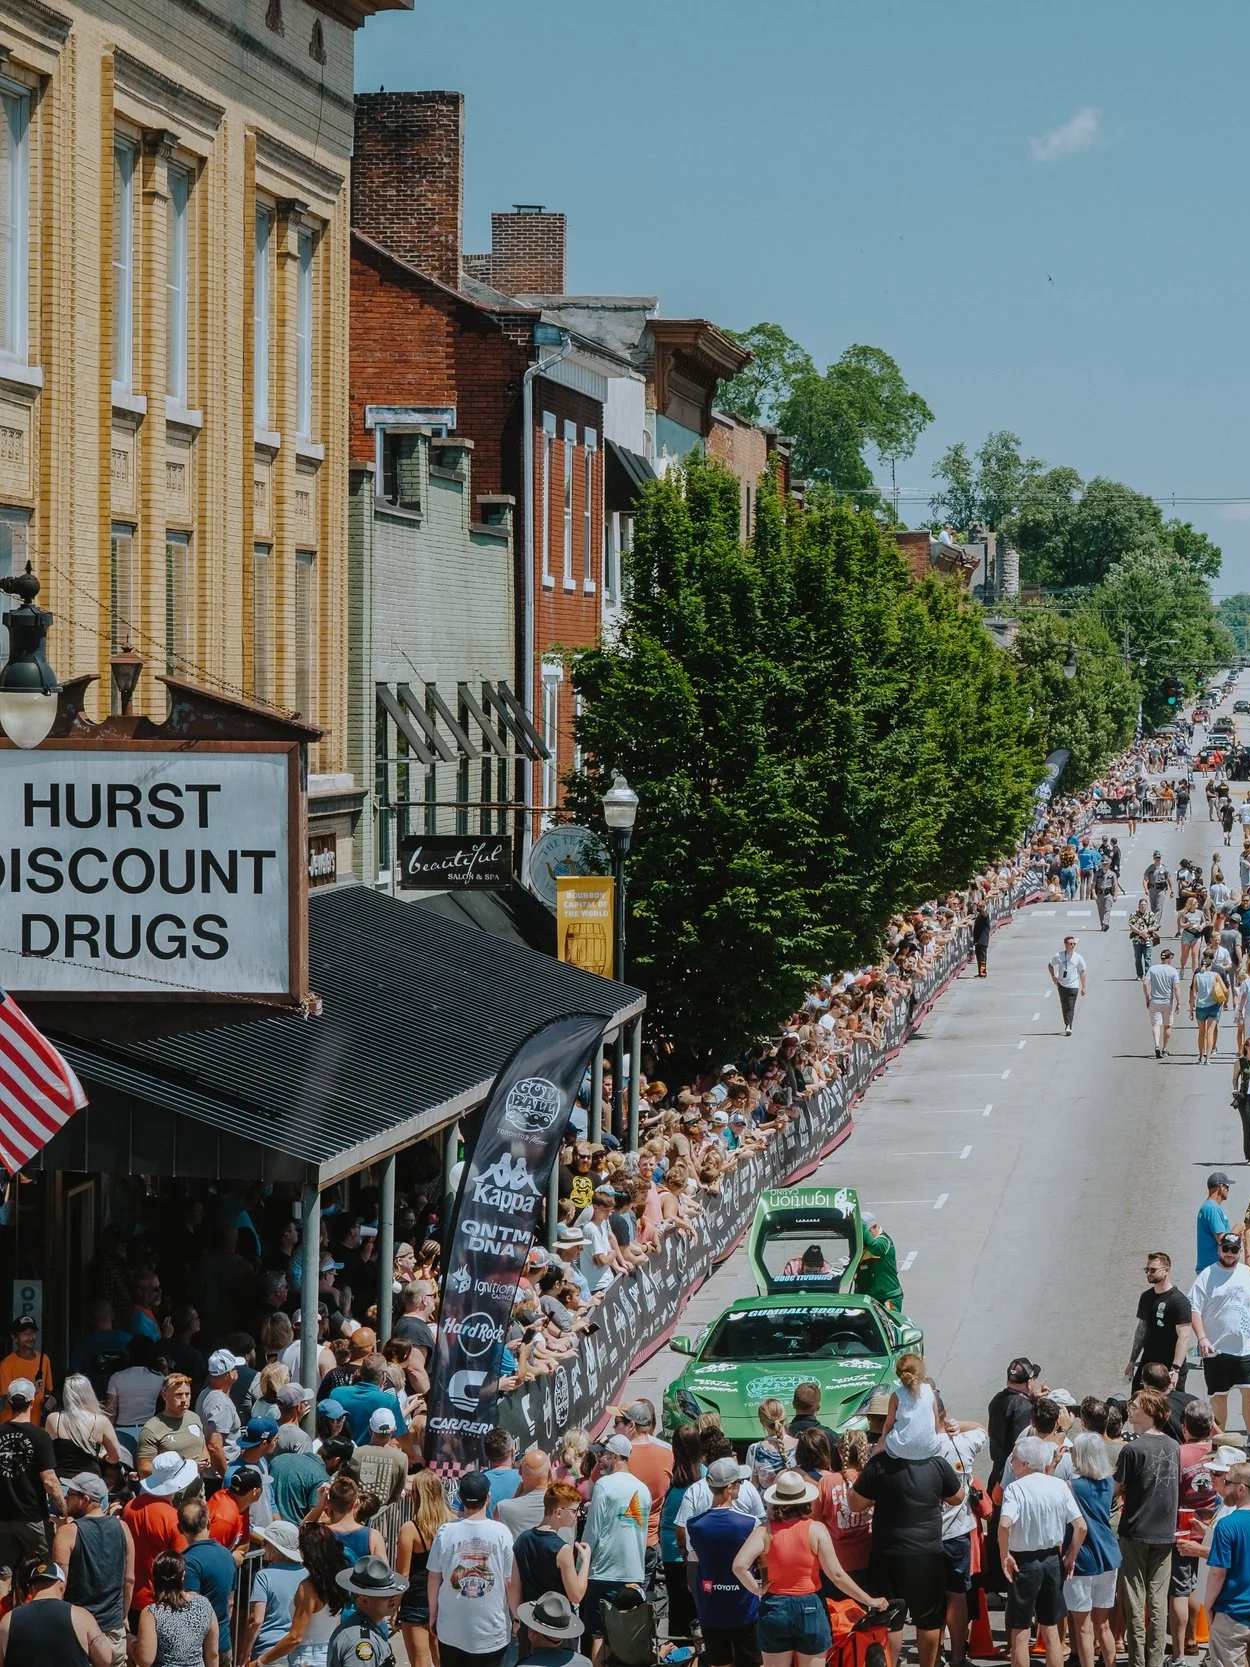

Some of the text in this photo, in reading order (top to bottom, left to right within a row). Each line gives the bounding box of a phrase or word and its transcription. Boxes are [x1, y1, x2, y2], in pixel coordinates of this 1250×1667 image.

[23, 783, 221, 829] HURST
[409, 842, 502, 884] beautiful
[566, 891, 605, 899] BOURBON
[21, 914, 229, 960] DRUGS
[496, 1128, 524, 1140] TORONTO
[472, 1182, 536, 1214] Kappa
[770, 1191, 830, 1208] Ignition
[461, 1219, 531, 1244] QNTM
[468, 1236, 515, 1257] DNA
[474, 1279, 514, 1295] Ignition
[20, 1286, 36, 1317] OP
[748, 1307, 808, 1317] GUMBALL
[442, 1317, 505, 1343] Hard Rock
[361, 1455, 393, 1465] FREEDOM
